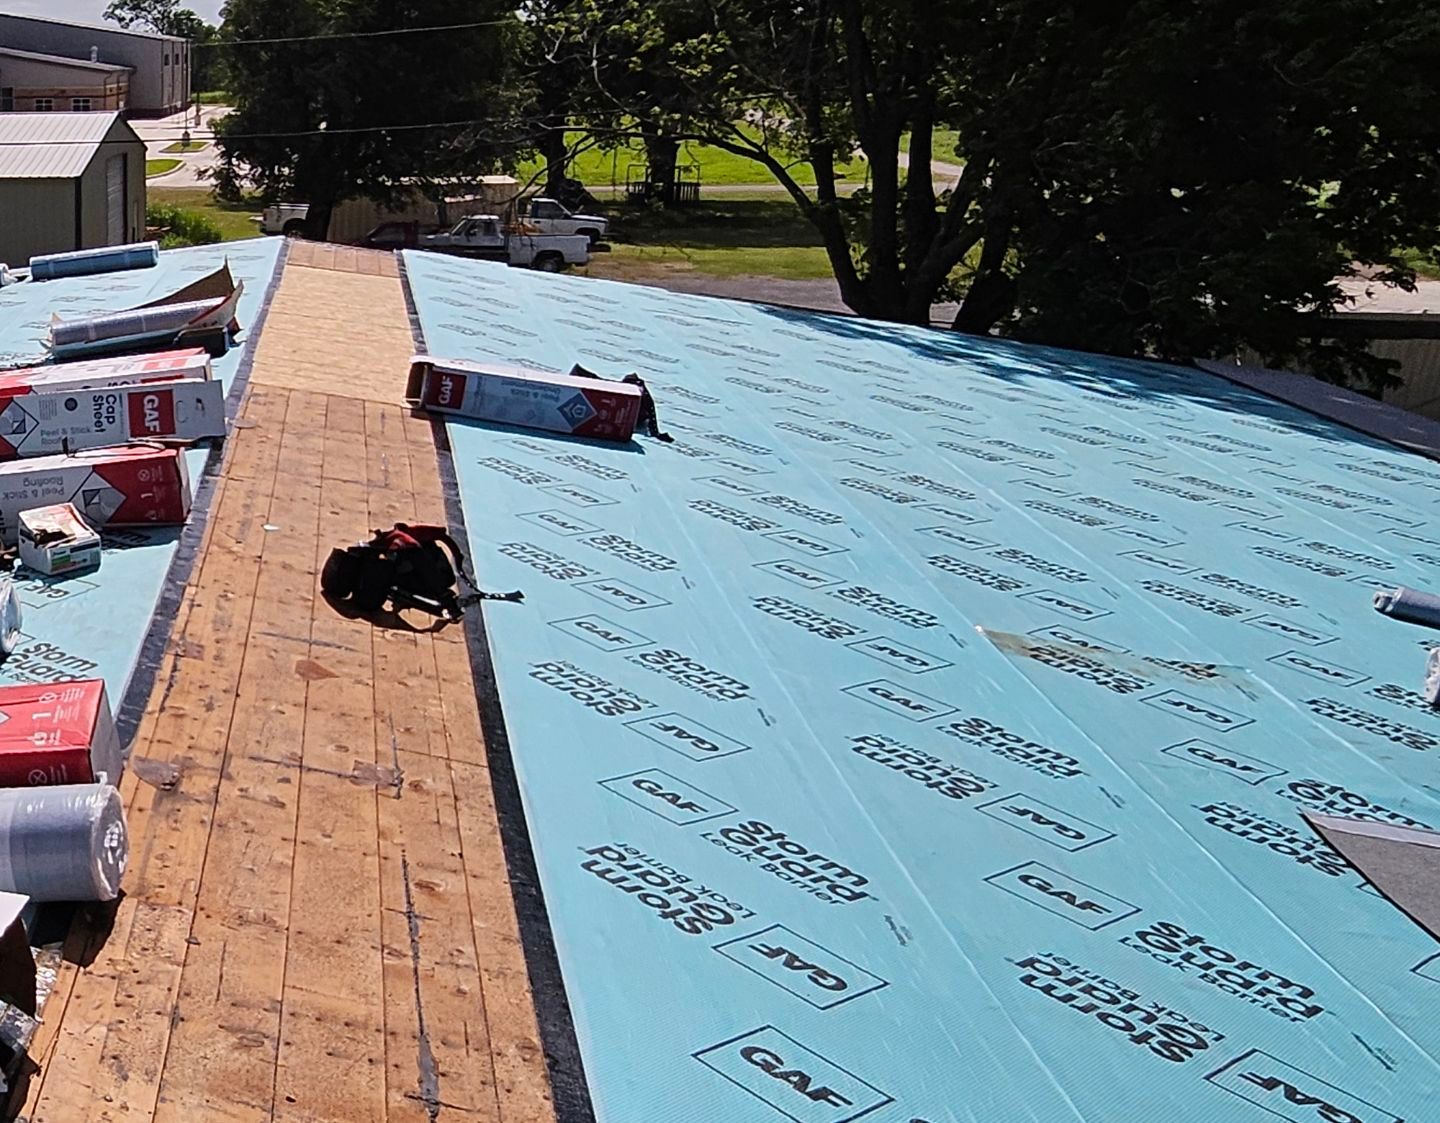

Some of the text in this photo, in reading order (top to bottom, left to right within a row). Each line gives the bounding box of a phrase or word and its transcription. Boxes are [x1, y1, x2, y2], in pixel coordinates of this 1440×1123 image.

[105, 394, 117, 424] Cap
[439, 376, 453, 404] GAF
[93, 395, 106, 433] Sheet
[144, 395, 160, 432] GAF
[538, 514, 584, 531] GAF
[593, 583, 648, 605] GAF
[774, 564, 829, 583] GAF
[574, 621, 633, 645] GAF
[753, 603, 837, 640] Storm
[23, 643, 99, 671] Storm
[639, 652, 748, 700] Guard
[654, 648, 750, 690] Storm
[865, 643, 929, 666] GAF
[1029, 654, 1134, 694] Storm
[529, 671, 623, 716] Storm
[535, 661, 643, 713] Guard
[868, 687, 936, 713] GAF
[1161, 698, 1233, 724] GAF
[649, 721, 719, 752] GAF
[949, 721, 1083, 778] Guard
[963, 716, 1081, 767] Storm
[1188, 746, 1266, 772] GAF
[851, 735, 986, 793] Guard
[851, 745, 972, 800] Storm
[632, 779, 710, 814] GAF
[1000, 805, 1087, 841] GAF
[699, 832, 847, 906] Leak Barrier
[719, 827, 869, 903] Guard
[738, 820, 870, 887] Storm
[579, 860, 714, 935] Storm
[586, 844, 736, 927] Guard
[613, 841, 759, 920] Leak Barrier
[1017, 873, 1113, 916] GAF
[747, 943, 848, 992] GAF
[1117, 936, 1308, 1023] Leak Barrier
[1134, 929, 1326, 1019] Guard
[1154, 920, 1318, 1000] Storm
[1015, 956, 1210, 1051] Guard
[1018, 973, 1195, 1064] Storm
[1038, 952, 1227, 1043] Leak Barrier
[739, 1045, 853, 1109] GAF
